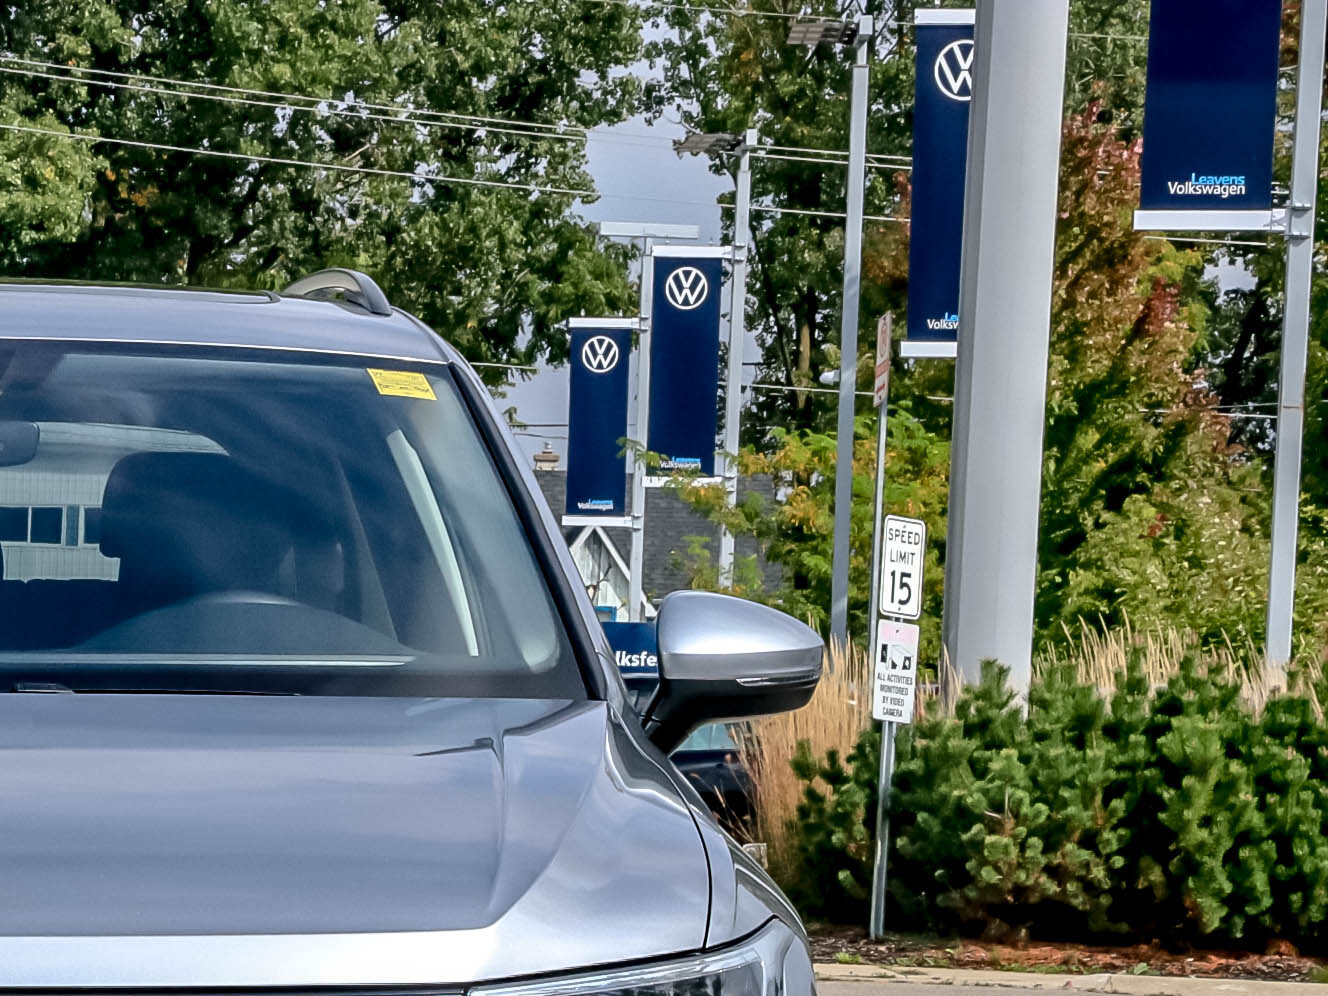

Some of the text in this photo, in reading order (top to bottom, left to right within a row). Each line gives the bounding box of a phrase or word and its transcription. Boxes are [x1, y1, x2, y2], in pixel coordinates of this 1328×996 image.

[1191, 172, 1246, 185] Leavens
[1167, 181, 1246, 198] Volkswagen
[887, 527, 921, 546] SPEED
[890, 548, 916, 565] LIMIT
[890, 569, 912, 606] 15
[615, 650, 658, 667] lksfe
